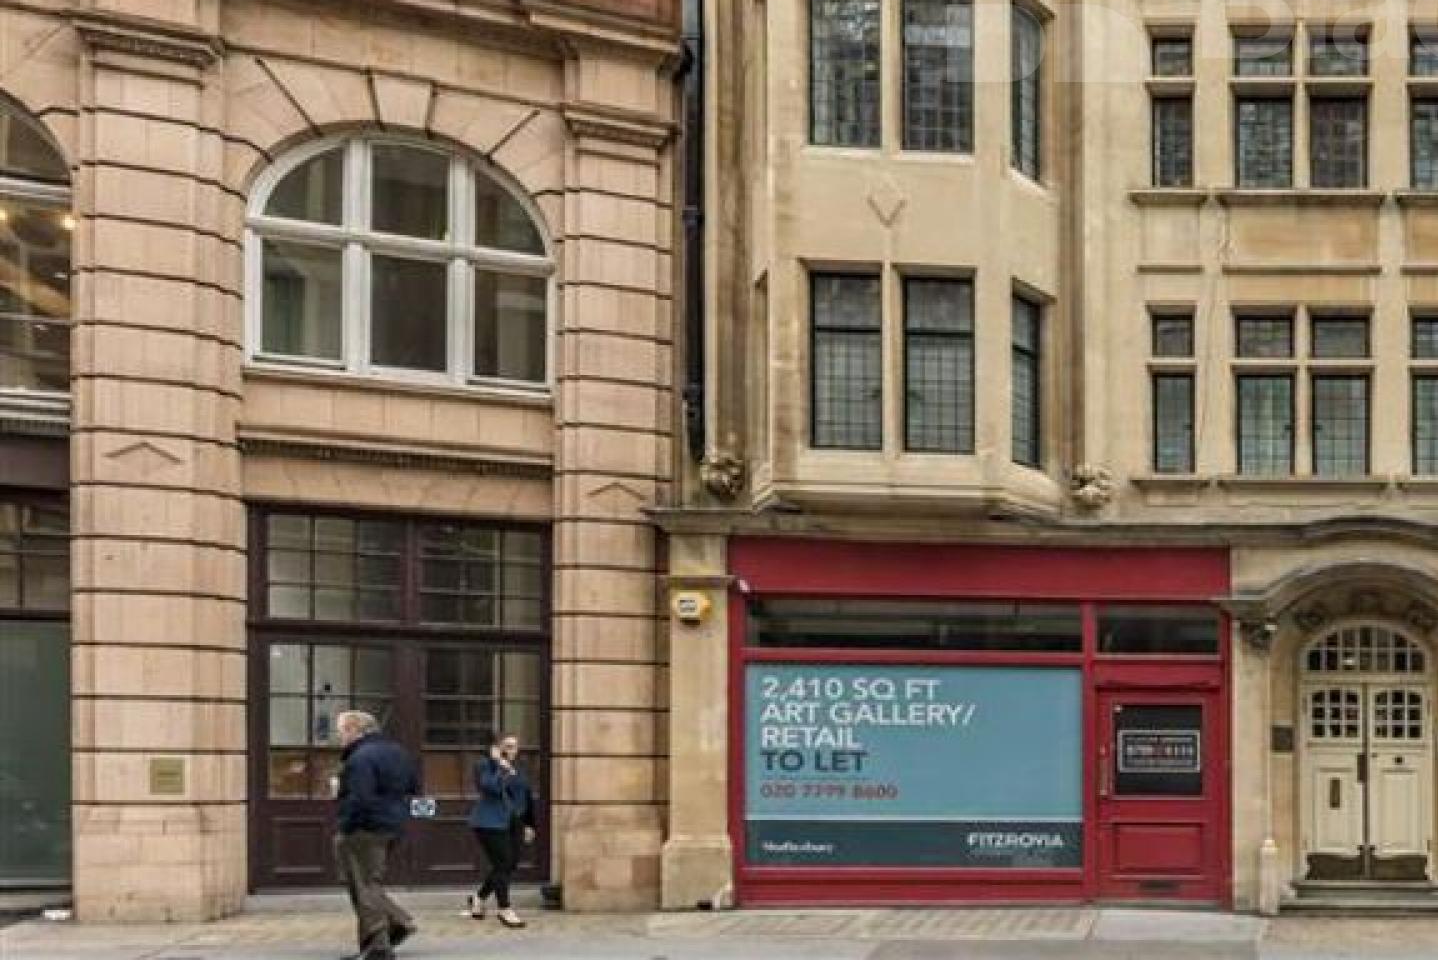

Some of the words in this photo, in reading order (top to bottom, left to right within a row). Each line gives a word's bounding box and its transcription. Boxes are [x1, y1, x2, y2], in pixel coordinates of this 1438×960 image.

[761, 677, 843, 701] 2,410
[851, 677, 897, 701] SQ
[904, 678, 941, 701] FT
[760, 702, 821, 724] ART
[829, 702, 976, 726] GALLERY/
[760, 726, 861, 749] RETAIL
[761, 750, 803, 772] TO
[814, 750, 868, 773] LET
